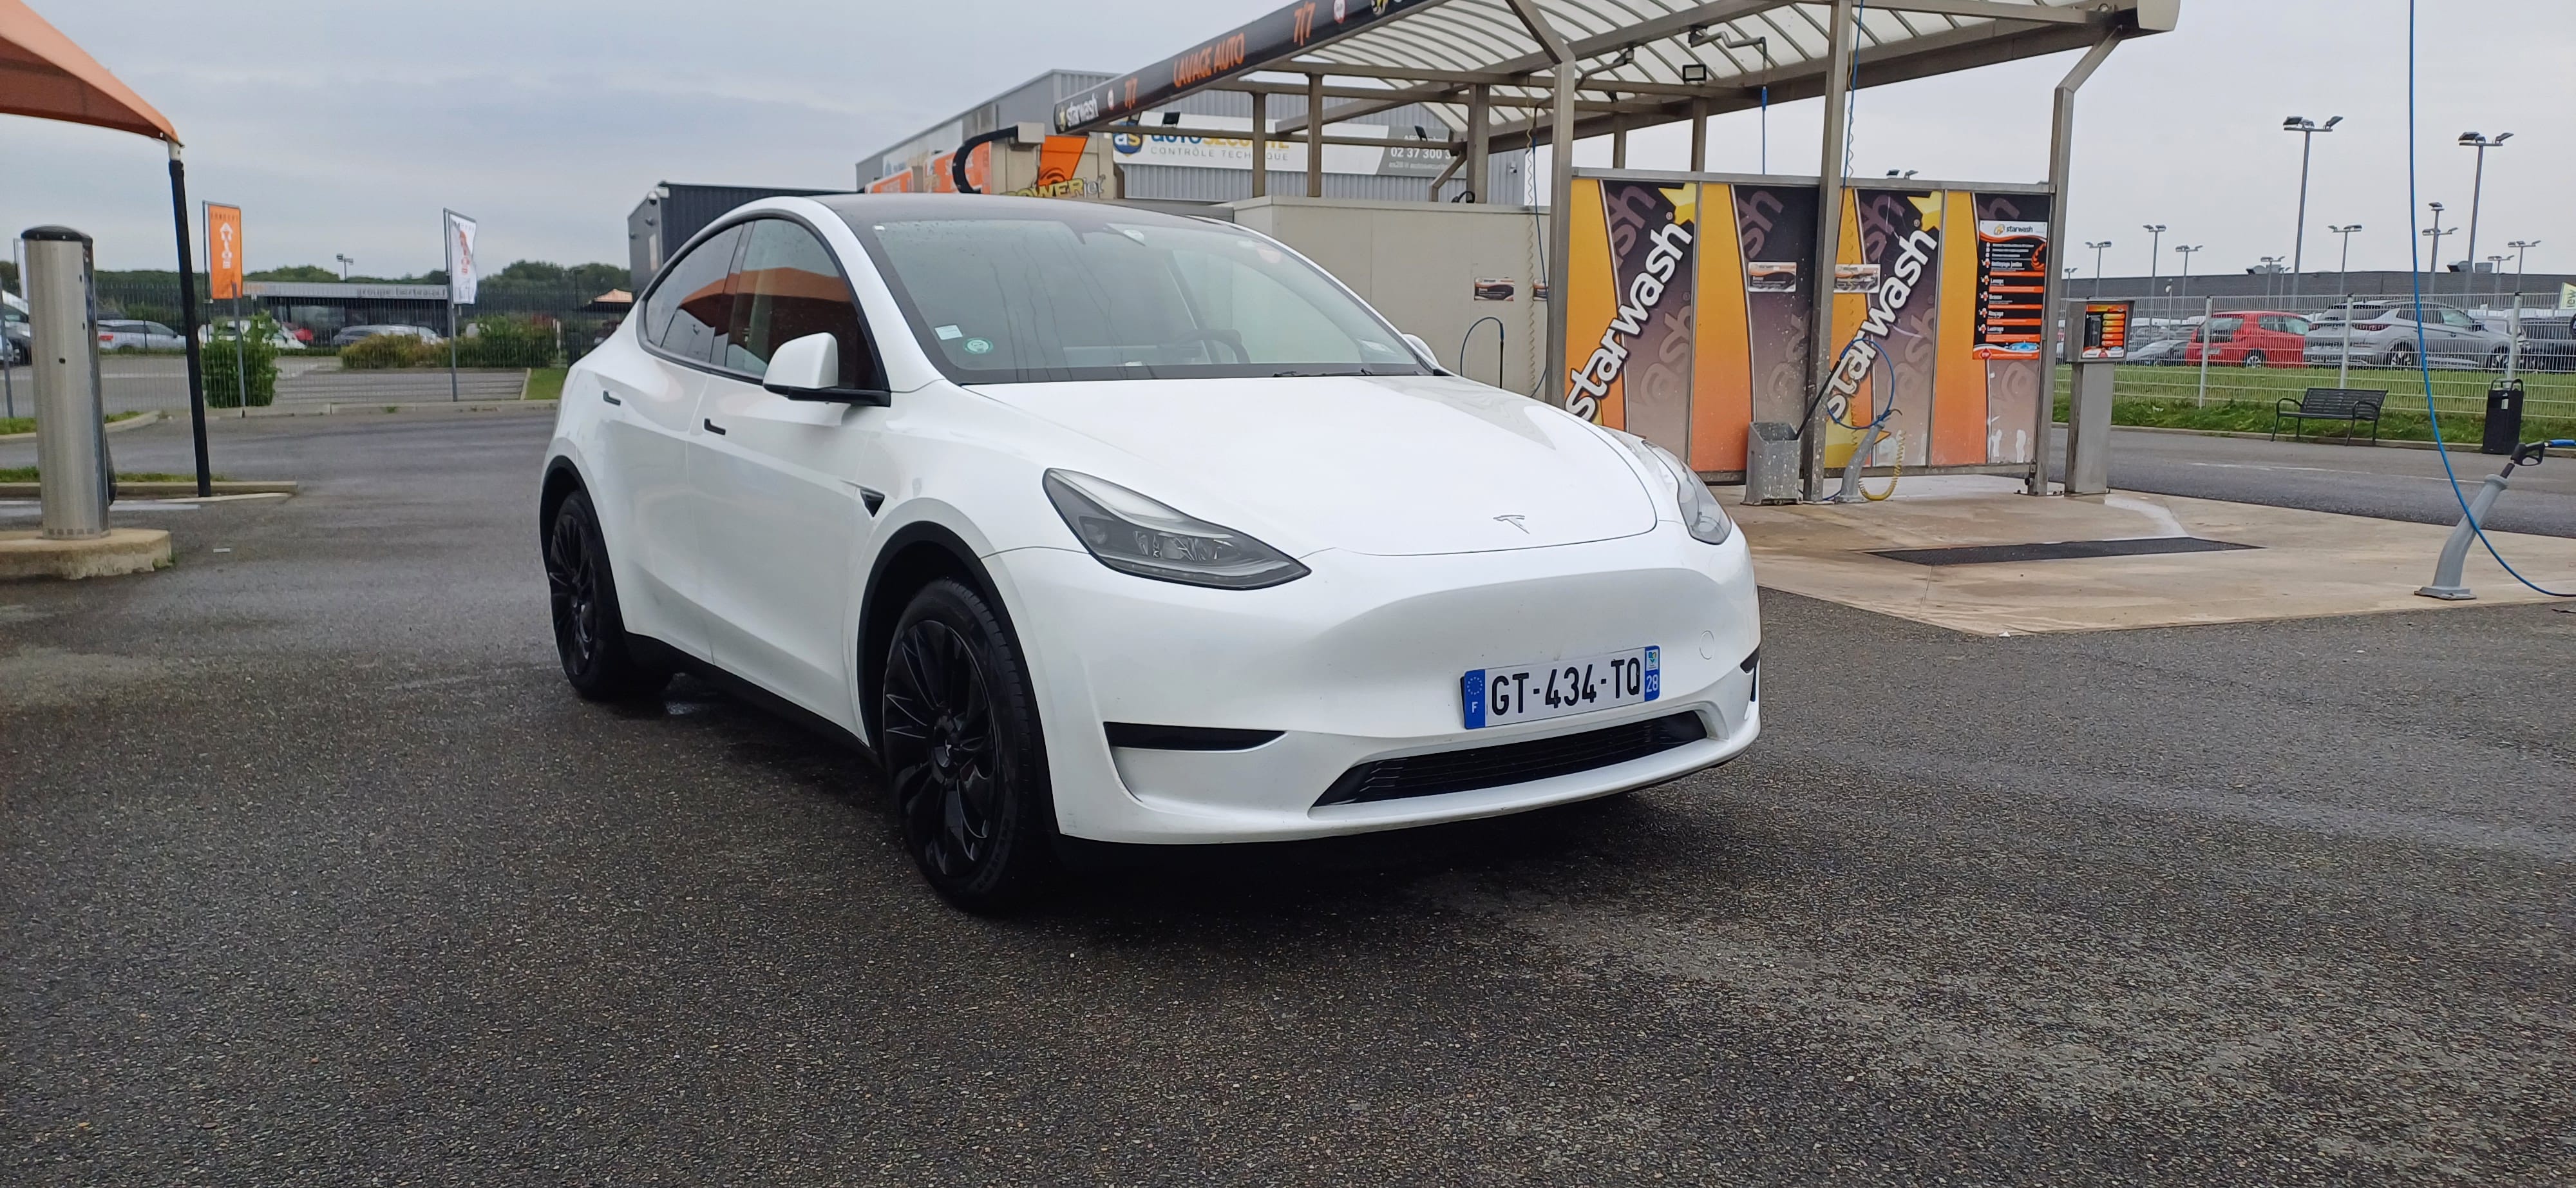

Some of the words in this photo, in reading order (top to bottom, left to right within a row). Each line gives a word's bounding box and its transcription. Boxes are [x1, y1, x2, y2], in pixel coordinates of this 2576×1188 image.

[1294, 1, 1316, 46] 7/7
[1173, 46, 1213, 88] LAVAGE
[1214, 32, 1245, 73] AUTO
[1066, 93, 1099, 128] starwash
[1124, 77, 1138, 109] 7/7
[1222, 149, 1289, 160] TECHQUE
[1390, 147, 1404, 157] 02
[1406, 148, 1420, 158] 37
[1423, 149, 1442, 159] 300
[1566, 223, 1693, 421] starwash
[1472, 701, 1479, 713] F
[1492, 657, 1640, 716] GT-434-TQ
[1646, 674, 1658, 693] 28
